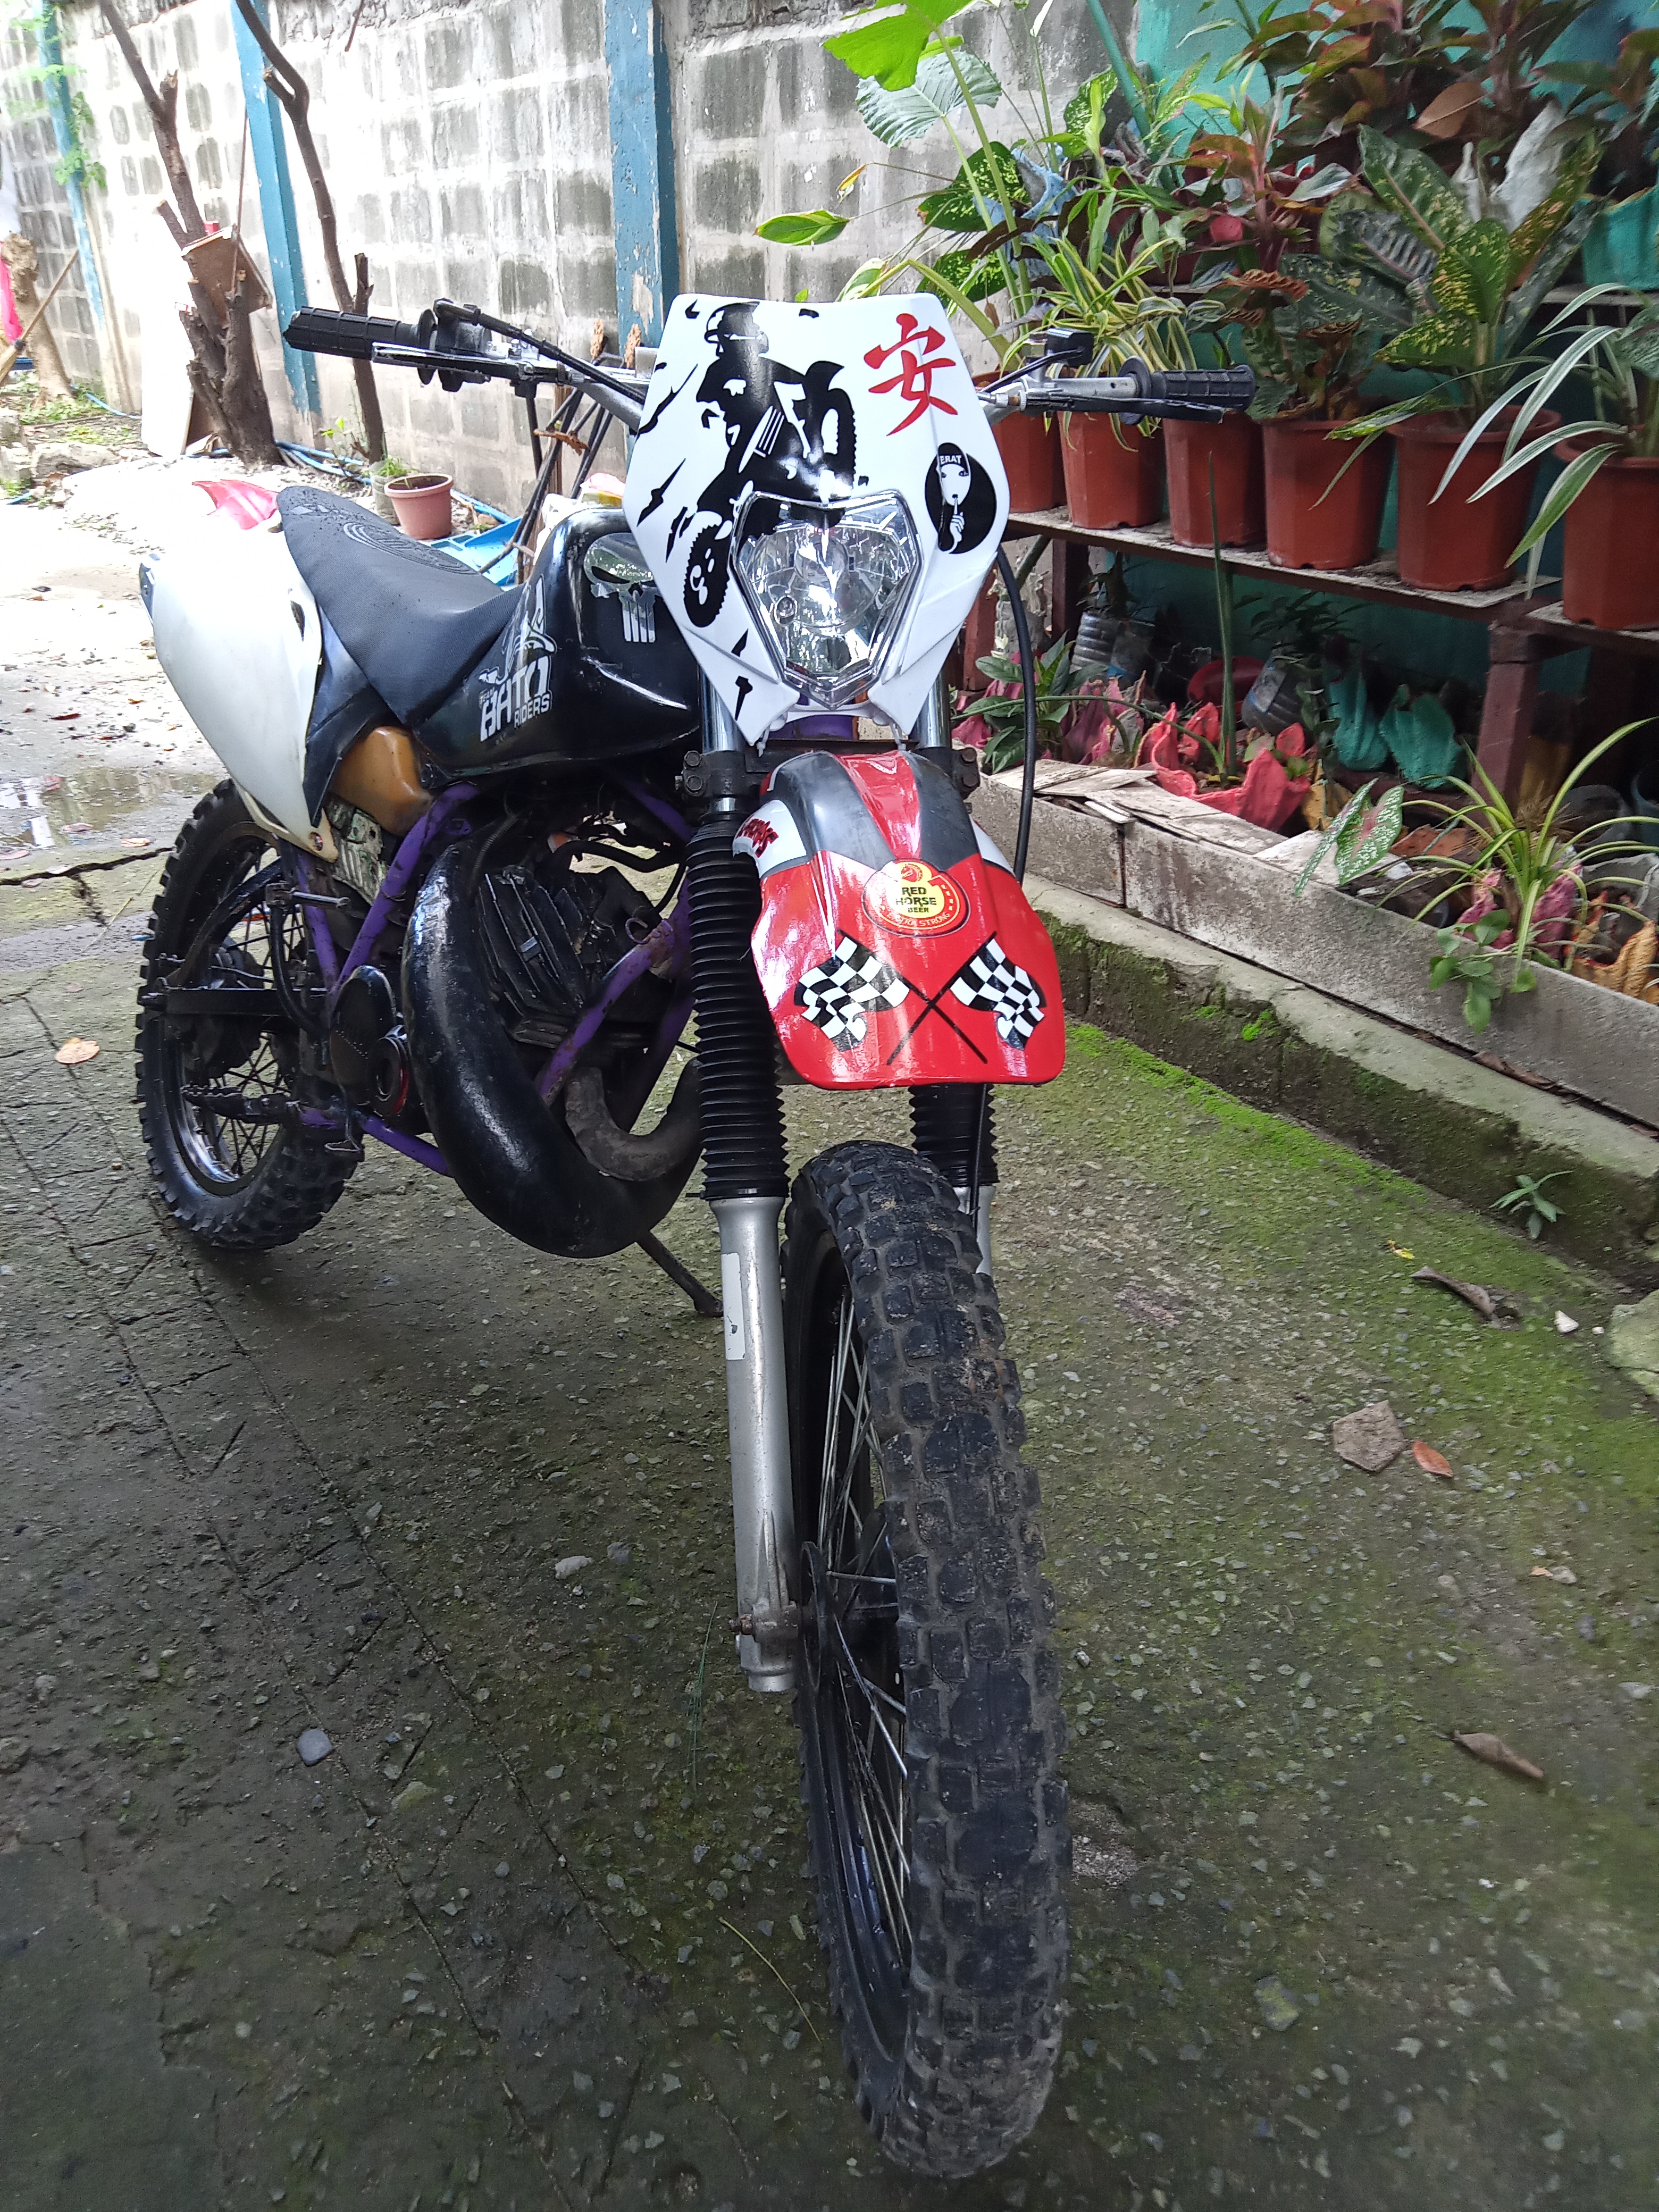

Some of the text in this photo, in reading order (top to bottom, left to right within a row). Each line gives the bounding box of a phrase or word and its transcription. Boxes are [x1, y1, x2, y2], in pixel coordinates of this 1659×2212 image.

[864, 313, 958, 436] 安
[514, 693, 550, 728] RIDERS
[902, 887, 927, 896] RED
[895, 897, 937, 907] HORSE
[887, 912, 950, 926] ETRA STRONG
